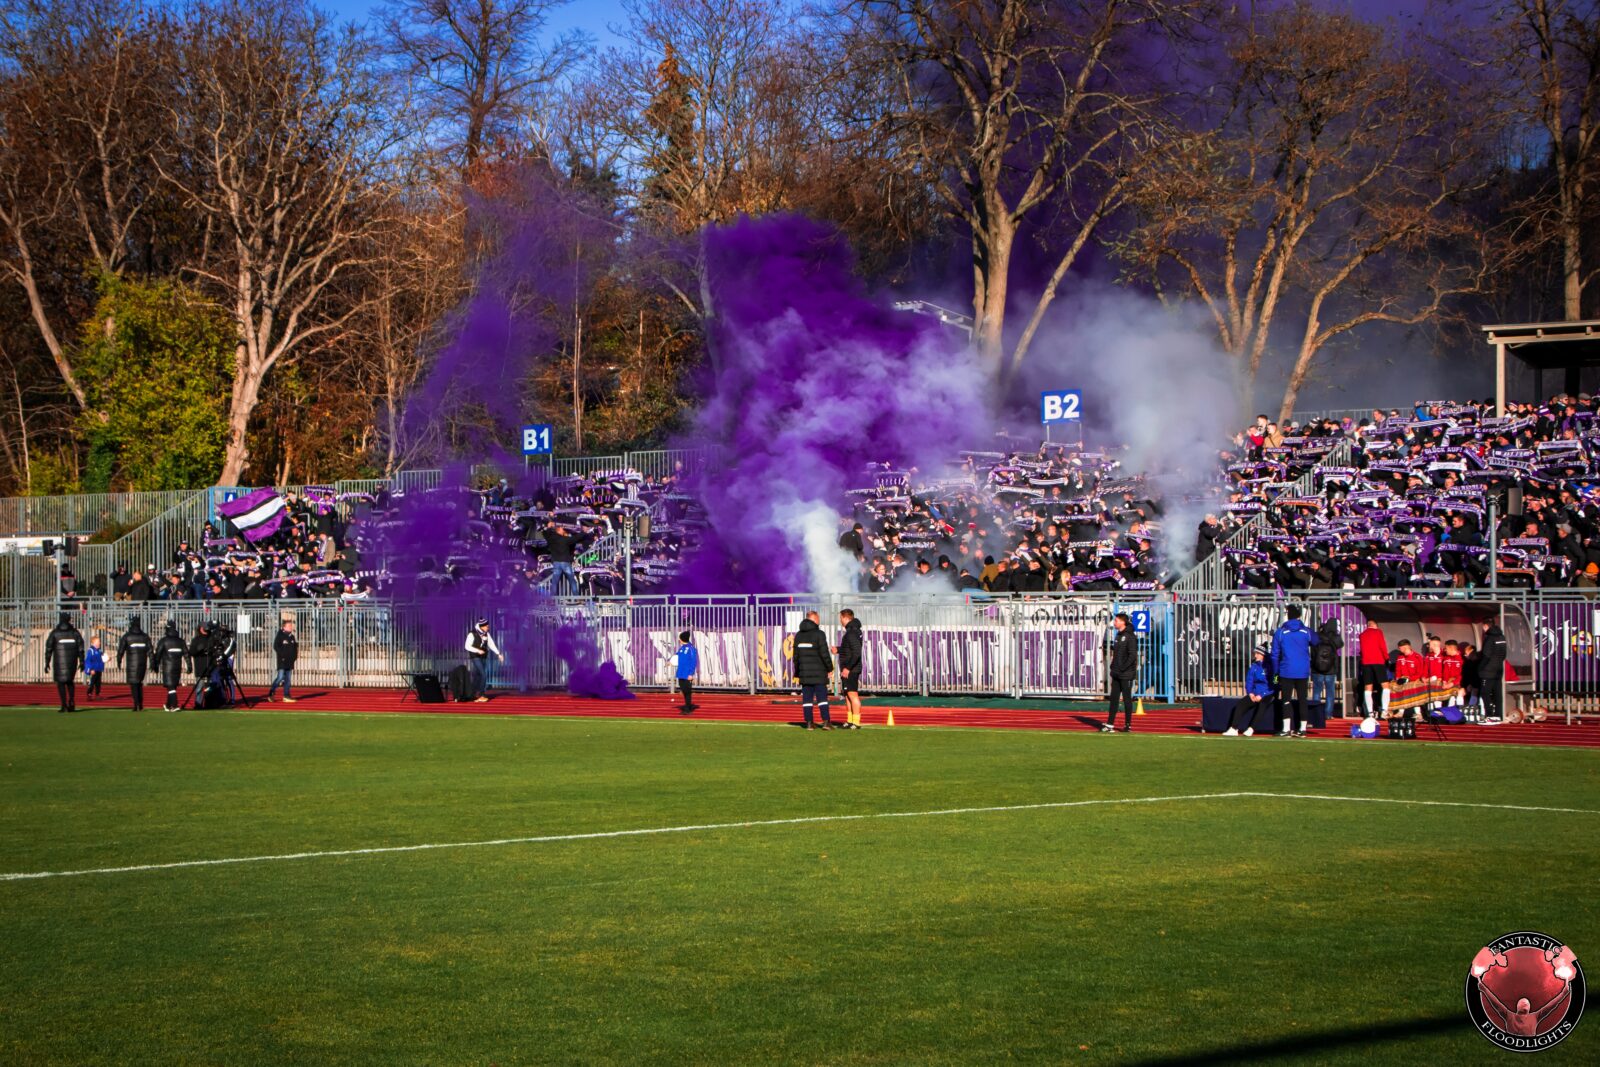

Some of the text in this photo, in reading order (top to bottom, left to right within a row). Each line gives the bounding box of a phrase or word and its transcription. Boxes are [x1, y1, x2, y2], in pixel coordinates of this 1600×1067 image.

[1044, 393, 1080, 420] B2
[523, 427, 549, 451] B1
[1137, 613, 1147, 630] 2
